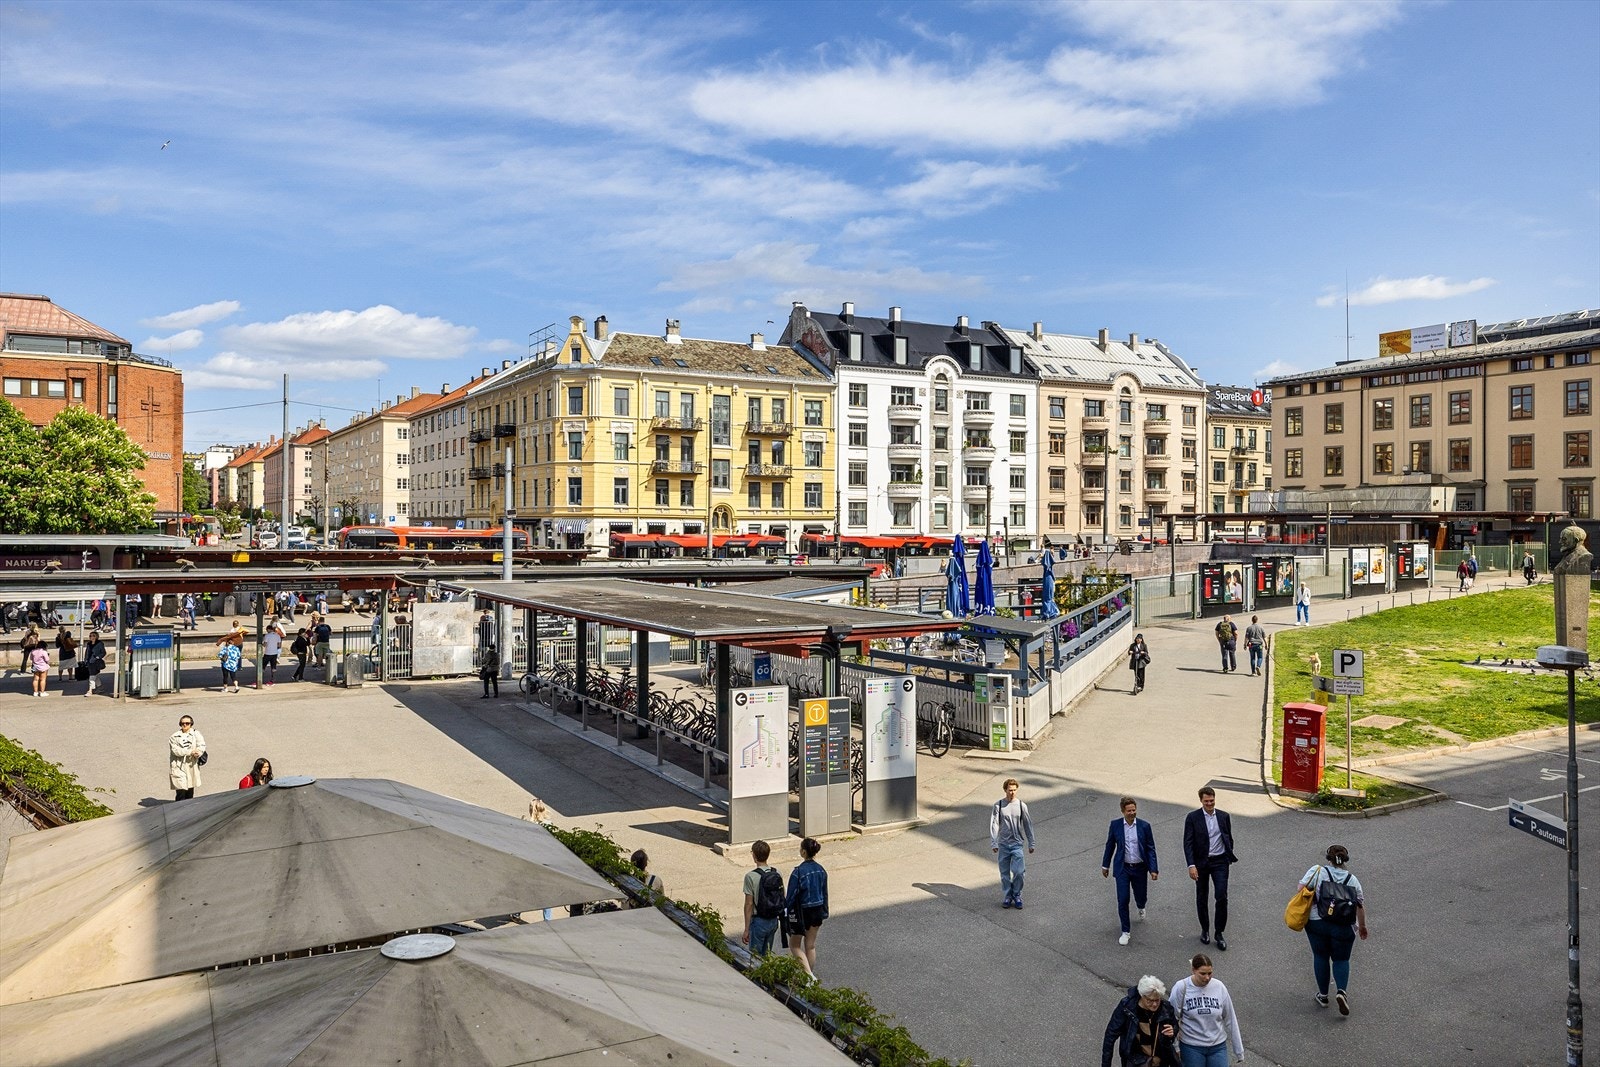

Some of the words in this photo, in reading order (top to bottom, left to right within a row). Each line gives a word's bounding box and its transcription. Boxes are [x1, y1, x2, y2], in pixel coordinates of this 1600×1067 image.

[1215, 390, 1252, 402] SpareBank
[1341, 654, 1356, 673] P
[1531, 820, 1565, 846] P-automat
[1203, 997, 1220, 1009] BEACH
